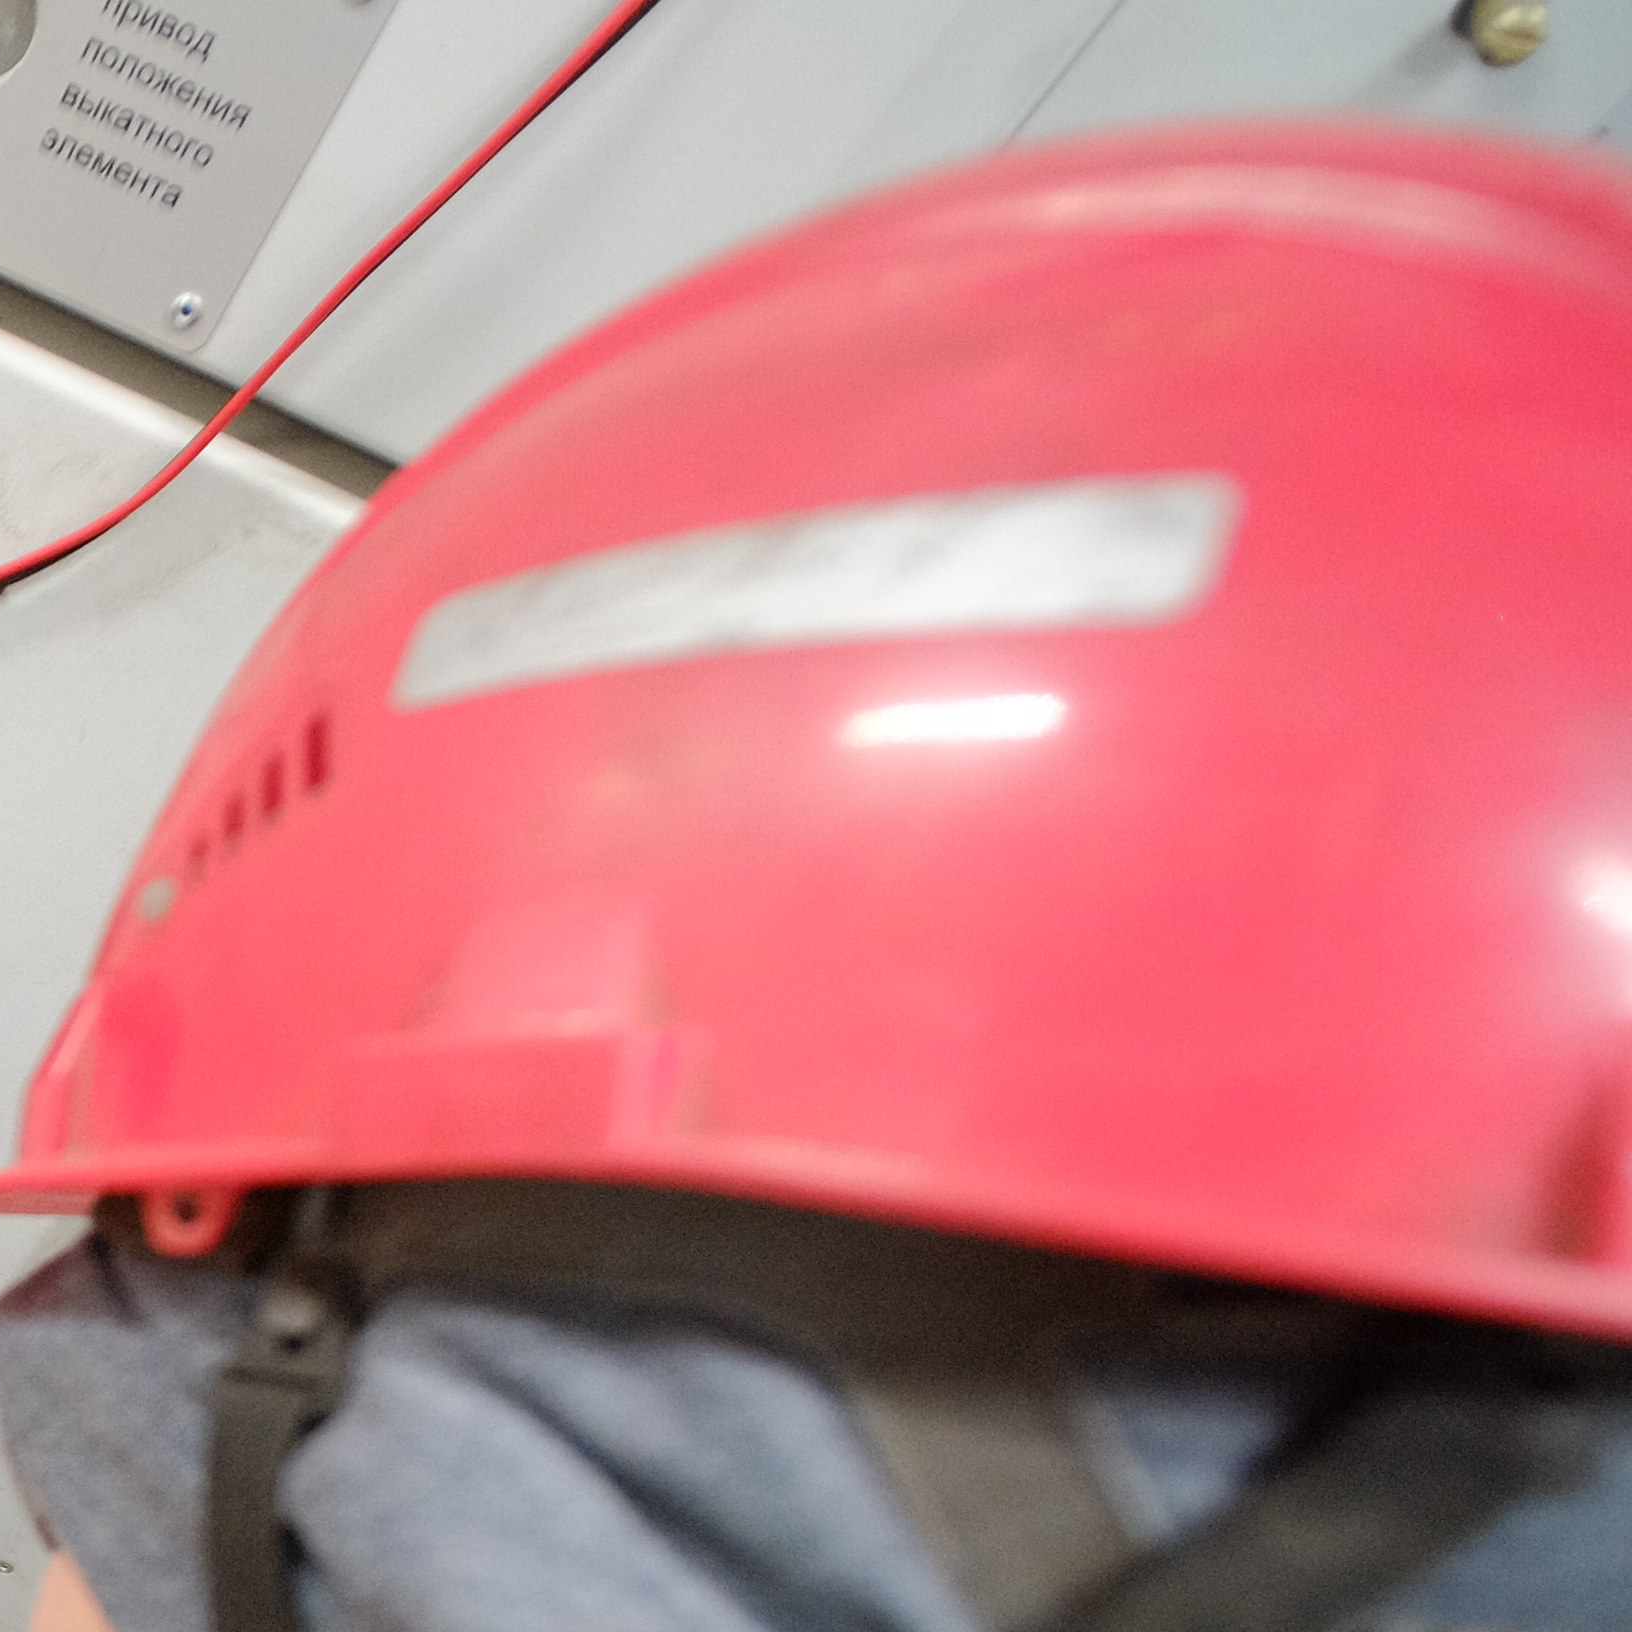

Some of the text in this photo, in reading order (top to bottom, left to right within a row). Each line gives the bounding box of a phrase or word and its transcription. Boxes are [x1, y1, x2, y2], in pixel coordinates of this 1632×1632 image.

[58, 81, 215, 169] выкатного
[80, 36, 252, 130] положения
[39, 126, 184, 209] элемента
